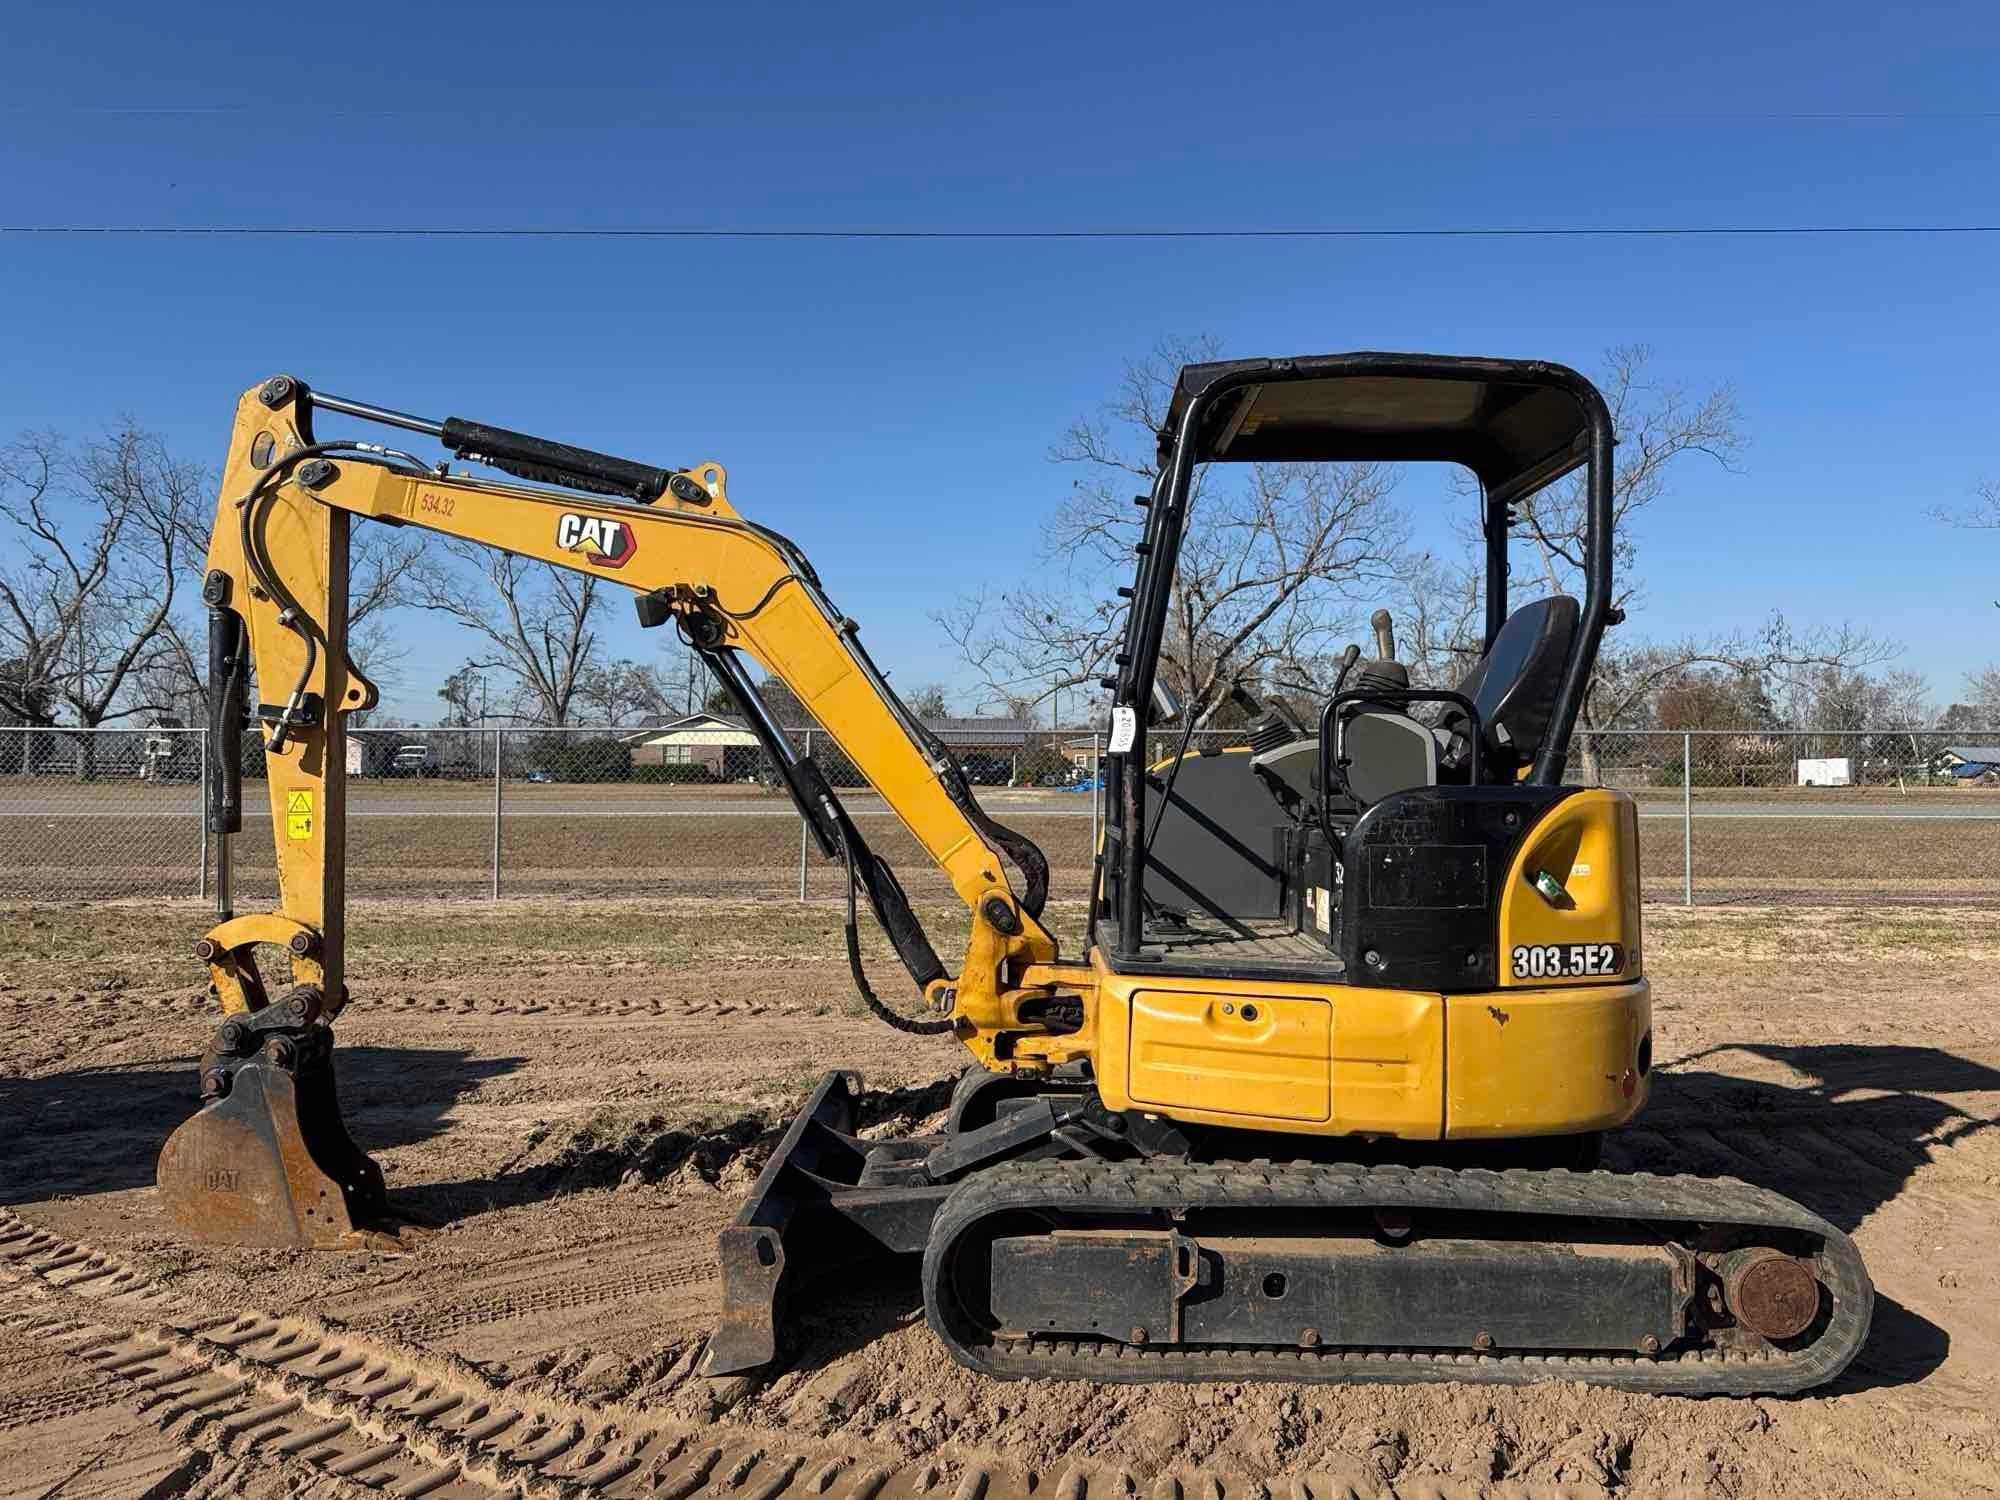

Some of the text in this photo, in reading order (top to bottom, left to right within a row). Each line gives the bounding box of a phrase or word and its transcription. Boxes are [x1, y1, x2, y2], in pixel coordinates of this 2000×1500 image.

[421, 493, 456, 517] 534.32
[557, 513, 622, 557] CAT
[1513, 944, 1615, 978] 303.5E2
[206, 1168, 241, 1192] CAT
